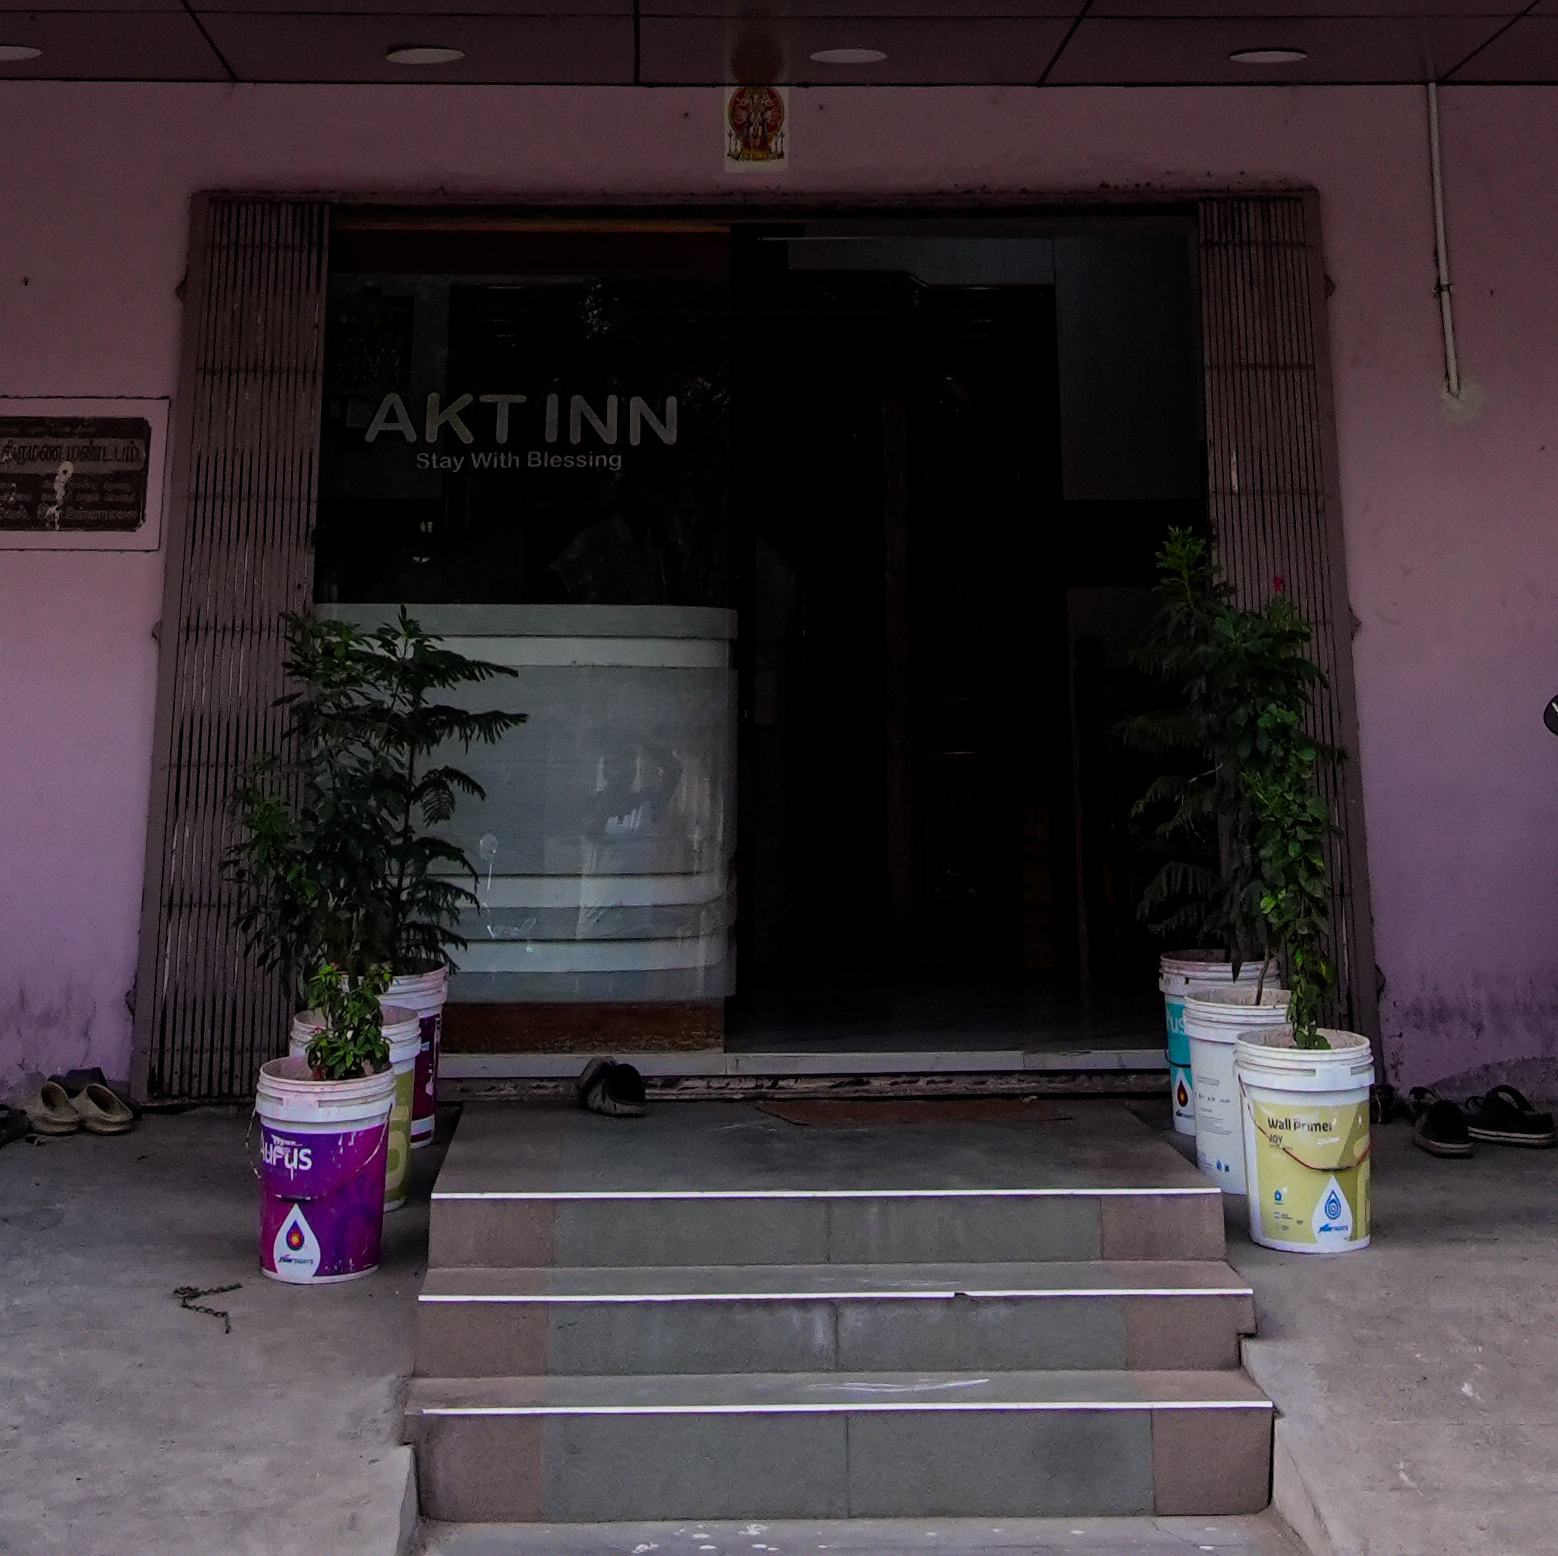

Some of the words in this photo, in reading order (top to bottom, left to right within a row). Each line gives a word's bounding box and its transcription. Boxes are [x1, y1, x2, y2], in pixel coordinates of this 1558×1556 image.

[365, 392, 527, 445] AKT
[546, 393, 678, 446] INN
[415, 452, 465, 472] Stay
[470, 452, 520, 468] With
[527, 450, 623, 470] Blessing
[1268, 1117, 1291, 1131] Wall
